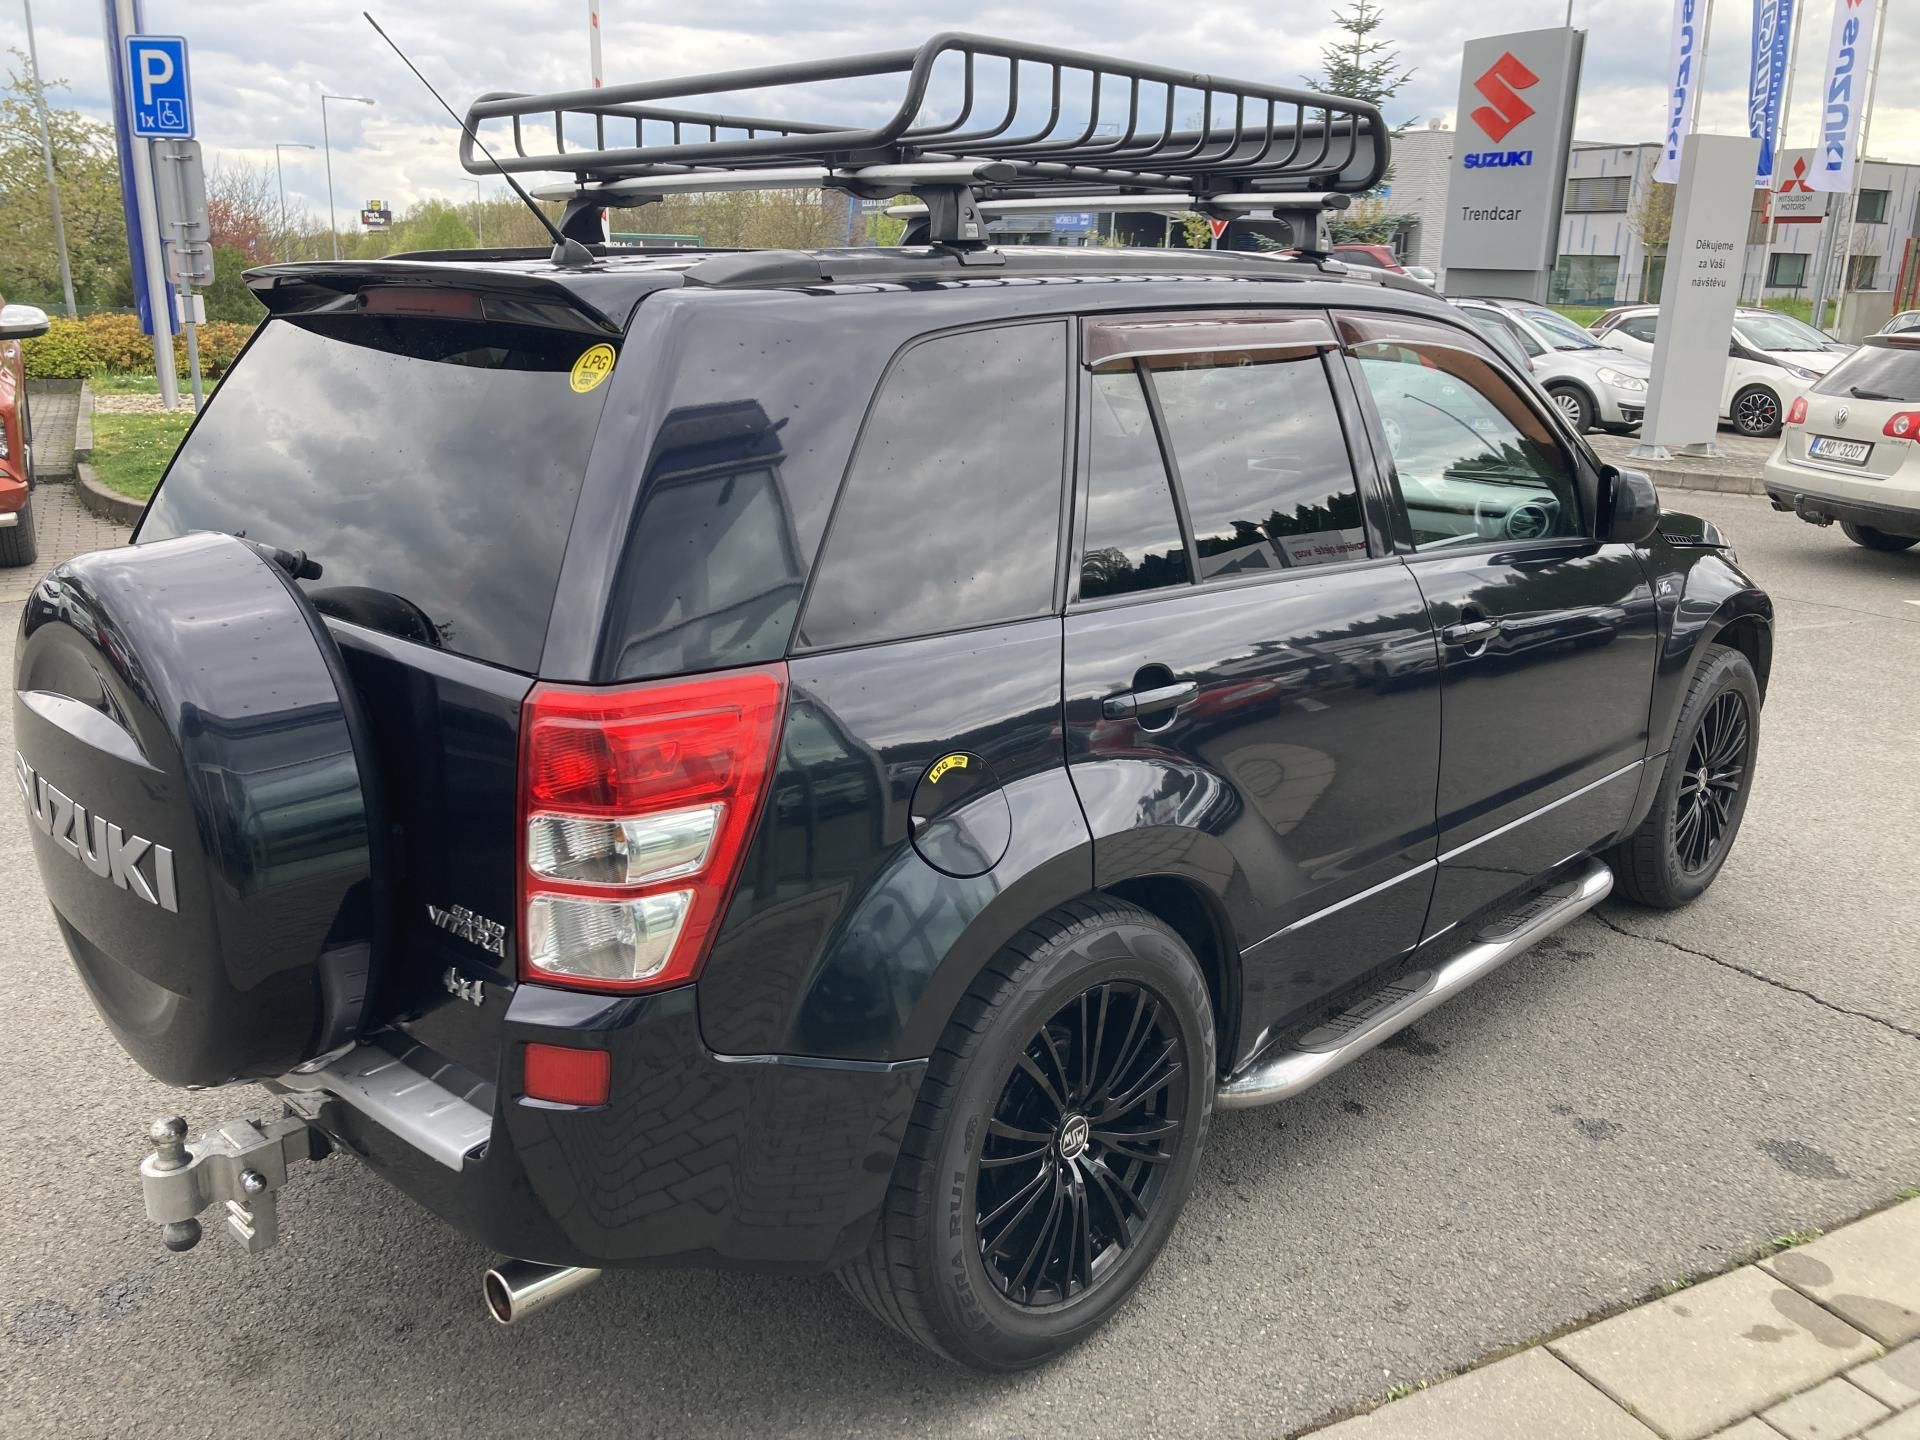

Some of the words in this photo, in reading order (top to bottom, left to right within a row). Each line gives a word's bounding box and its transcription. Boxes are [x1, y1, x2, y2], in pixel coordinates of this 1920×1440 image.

[139, 49, 174, 105] P
[139, 112, 155, 128] 1x
[1463, 150, 1533, 169] SUZUKI
[1778, 195, 1813, 203] MITSUBISHI
[1462, 206, 1522, 221] Trendcar
[1695, 239, 1734, 252] Děkujeme
[1698, 260, 1708, 268] za
[1709, 258, 1726, 269] Vaši
[1691, 276, 1727, 288] návštěvu
[582, 354, 609, 370] LPG
[1840, 442, 1866, 459] 3207
[931, 761, 948, 780] LPG
[1063, 1123, 1086, 1152] MSW
